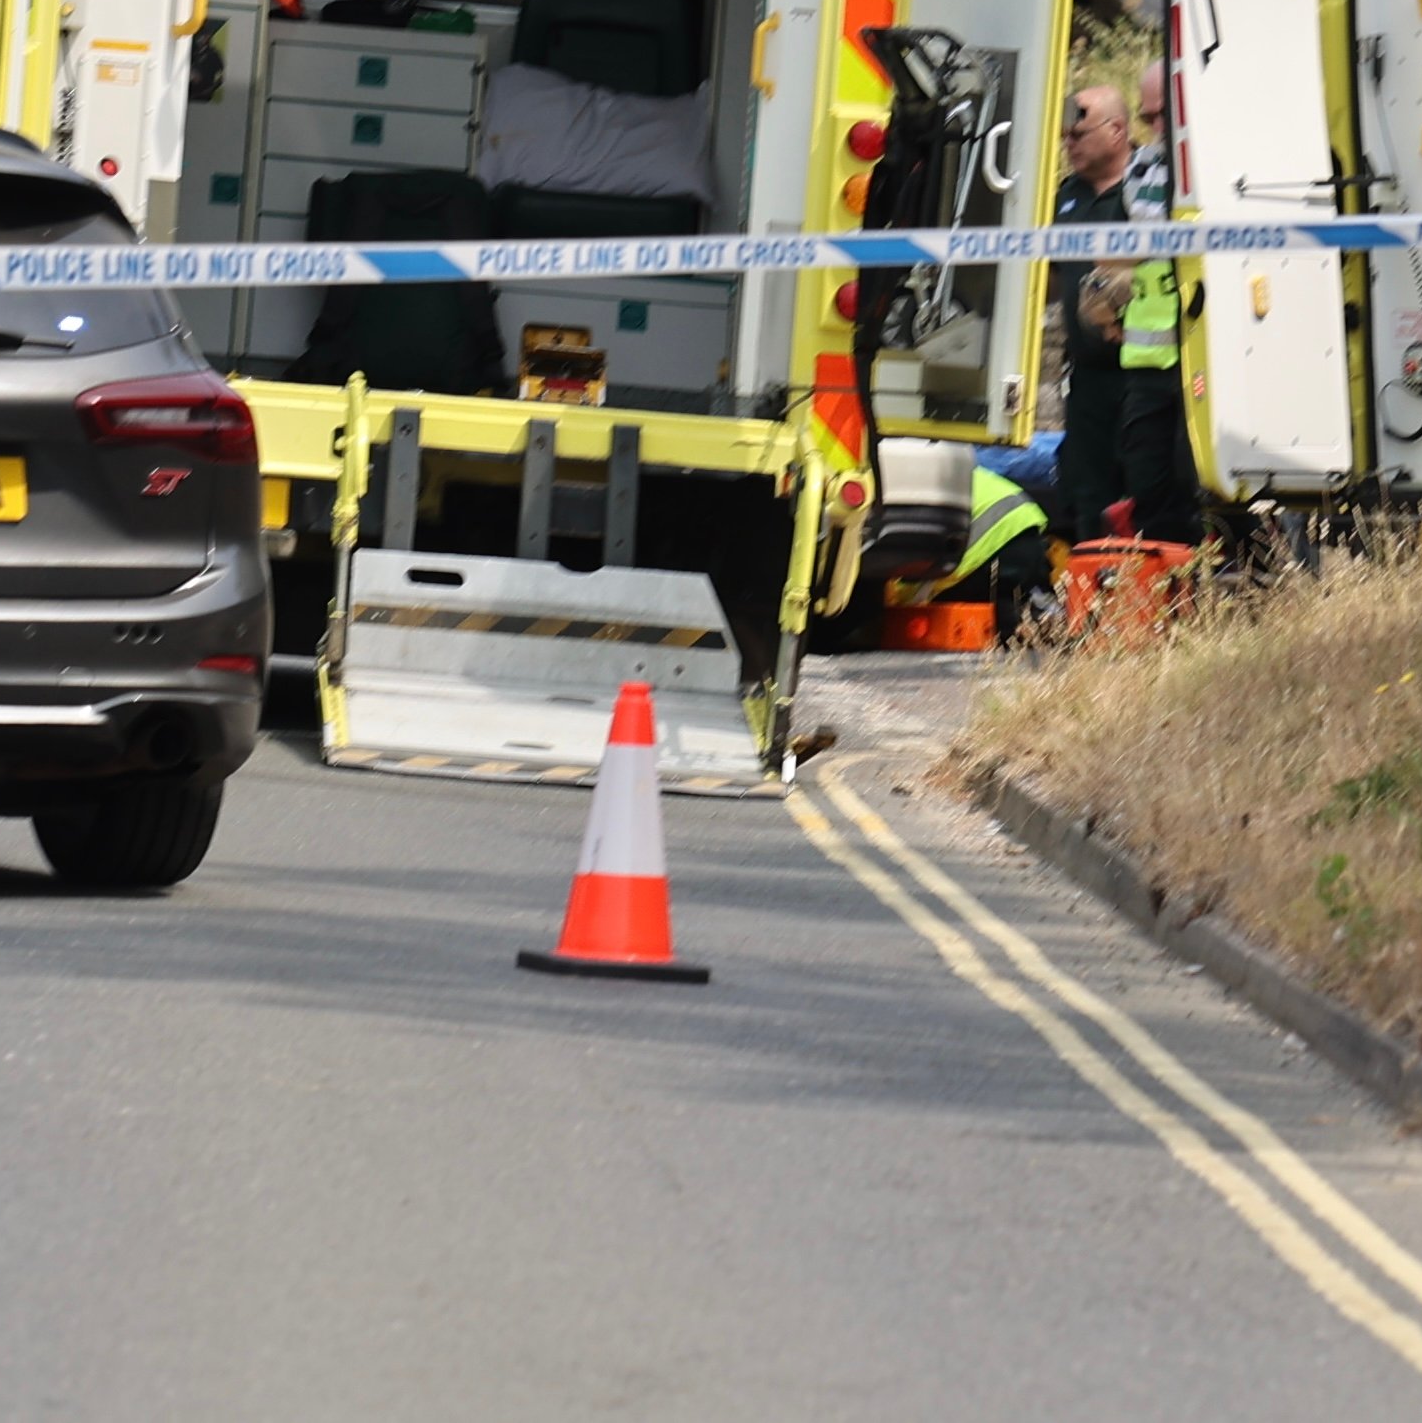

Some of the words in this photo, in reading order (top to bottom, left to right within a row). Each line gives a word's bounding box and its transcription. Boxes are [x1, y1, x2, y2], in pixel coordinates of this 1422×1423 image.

[478, 245, 563, 275] POLICE
[573, 243, 626, 273] LINE
[637, 242, 669, 271] DO
[680, 240, 728, 270] NOT
[737, 237, 817, 267] CROSS
[947, 228, 1034, 259] POLICE
[1043, 228, 1099, 256] LINE
[1107, 228, 1141, 255] DO
[1150, 227, 1199, 254] NOT
[1206, 224, 1288, 252] CROSS
[6, 252, 93, 285] POLICE
[103, 251, 154, 283] LINE
[165, 250, 198, 283] DO
[209, 249, 259, 282] NOT
[266, 248, 348, 281] CROSS
